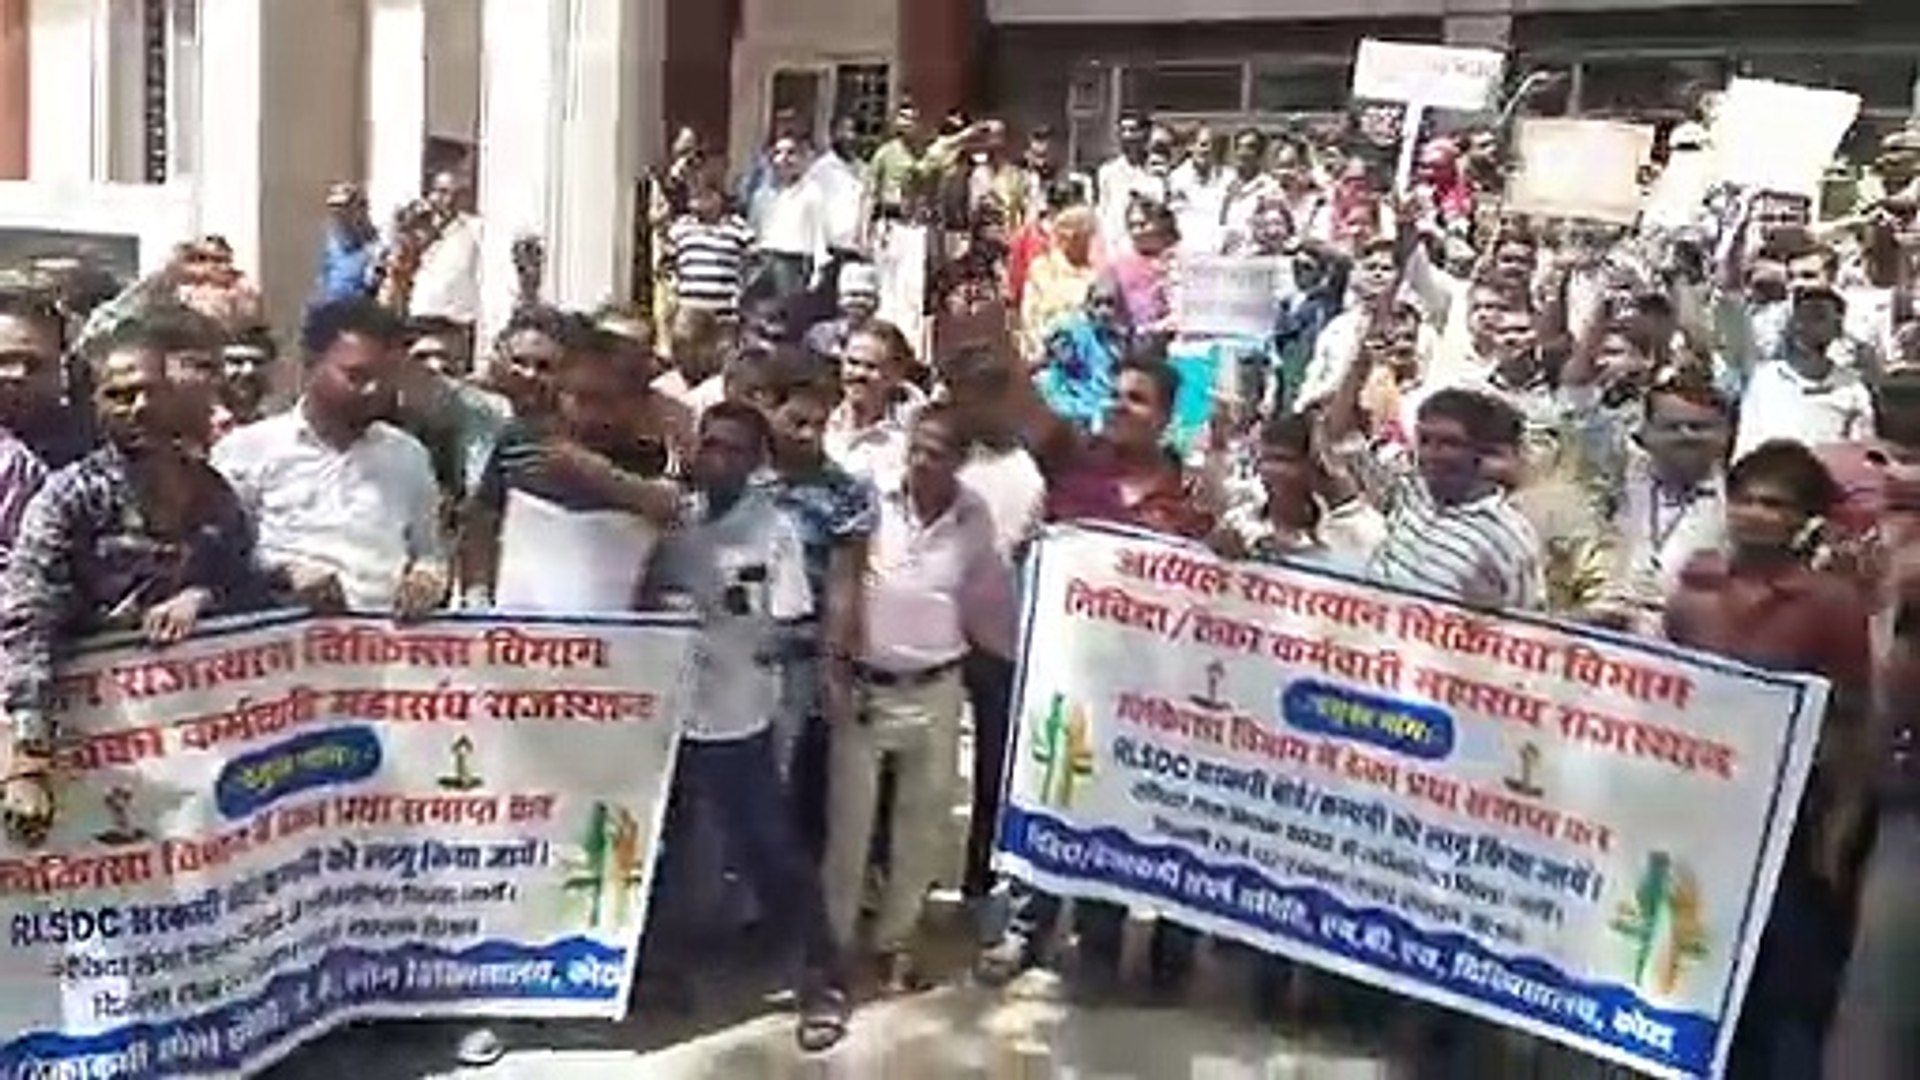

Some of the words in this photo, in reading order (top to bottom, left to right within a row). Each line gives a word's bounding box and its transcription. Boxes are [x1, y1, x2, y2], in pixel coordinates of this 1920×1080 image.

[110, 642, 295, 697] राजस्थान
[303, 626, 471, 668] चिकित्सा
[485, 627, 611, 668] विभाग
[1240, 572, 1386, 632] राजस्थान
[1399, 603, 1550, 672] चिकित्सा
[1563, 642, 1697, 708] विभाग
[1270, 632, 1402, 690] कर्मचारी
[1113, 735, 1191, 781] RLSDC
[9, 905, 121, 946] RLSDC
